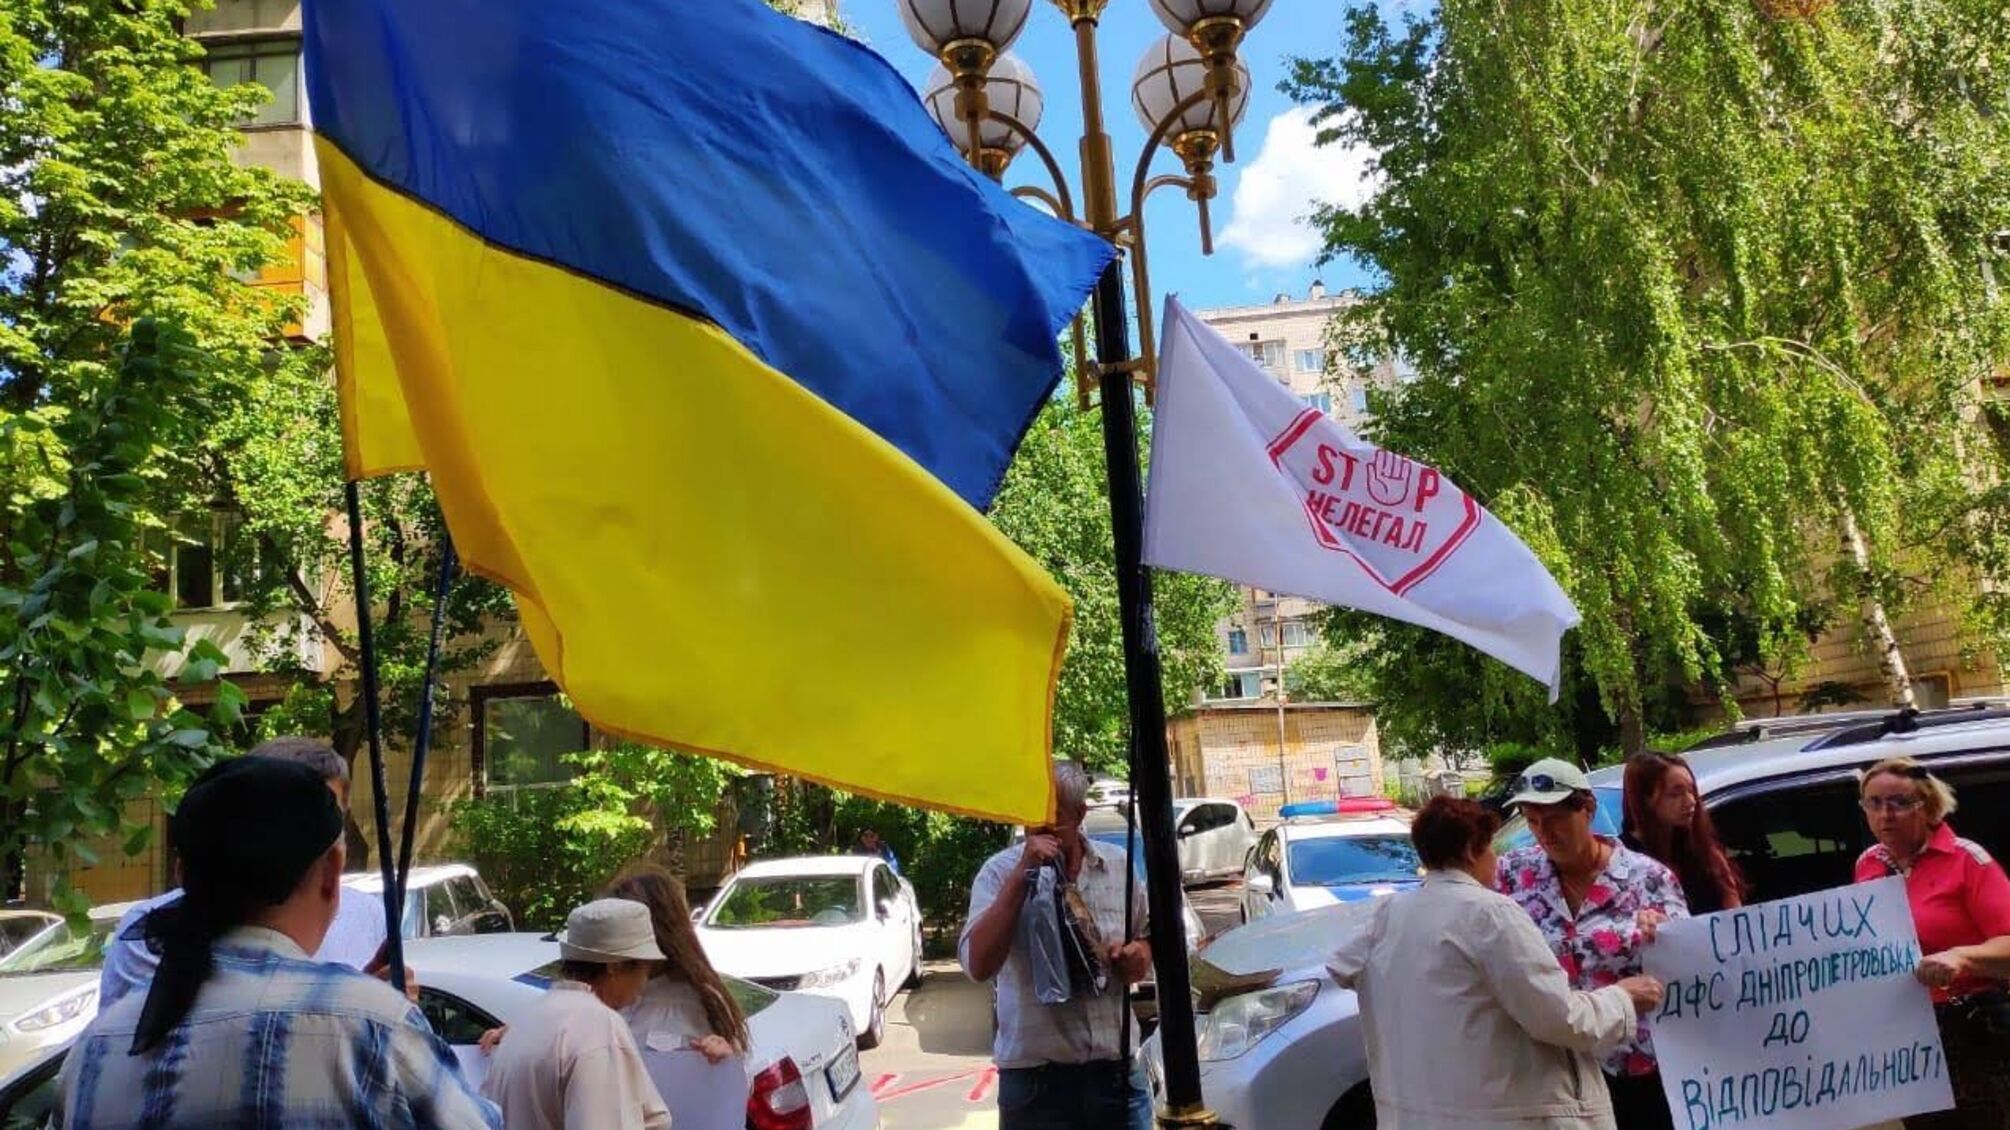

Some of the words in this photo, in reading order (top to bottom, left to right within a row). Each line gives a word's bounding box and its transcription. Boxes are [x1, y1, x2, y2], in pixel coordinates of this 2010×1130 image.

[1306, 490, 1427, 553] НЕЛЕГАЛ
[1710, 895, 1876, 963] СЛІДЧИХ
[1656, 971, 1725, 1023] ДФС
[1763, 1010, 1810, 1047] ДО
[1682, 1039, 1941, 1130] ВІДПОВІДАЛЬНОСТІ
